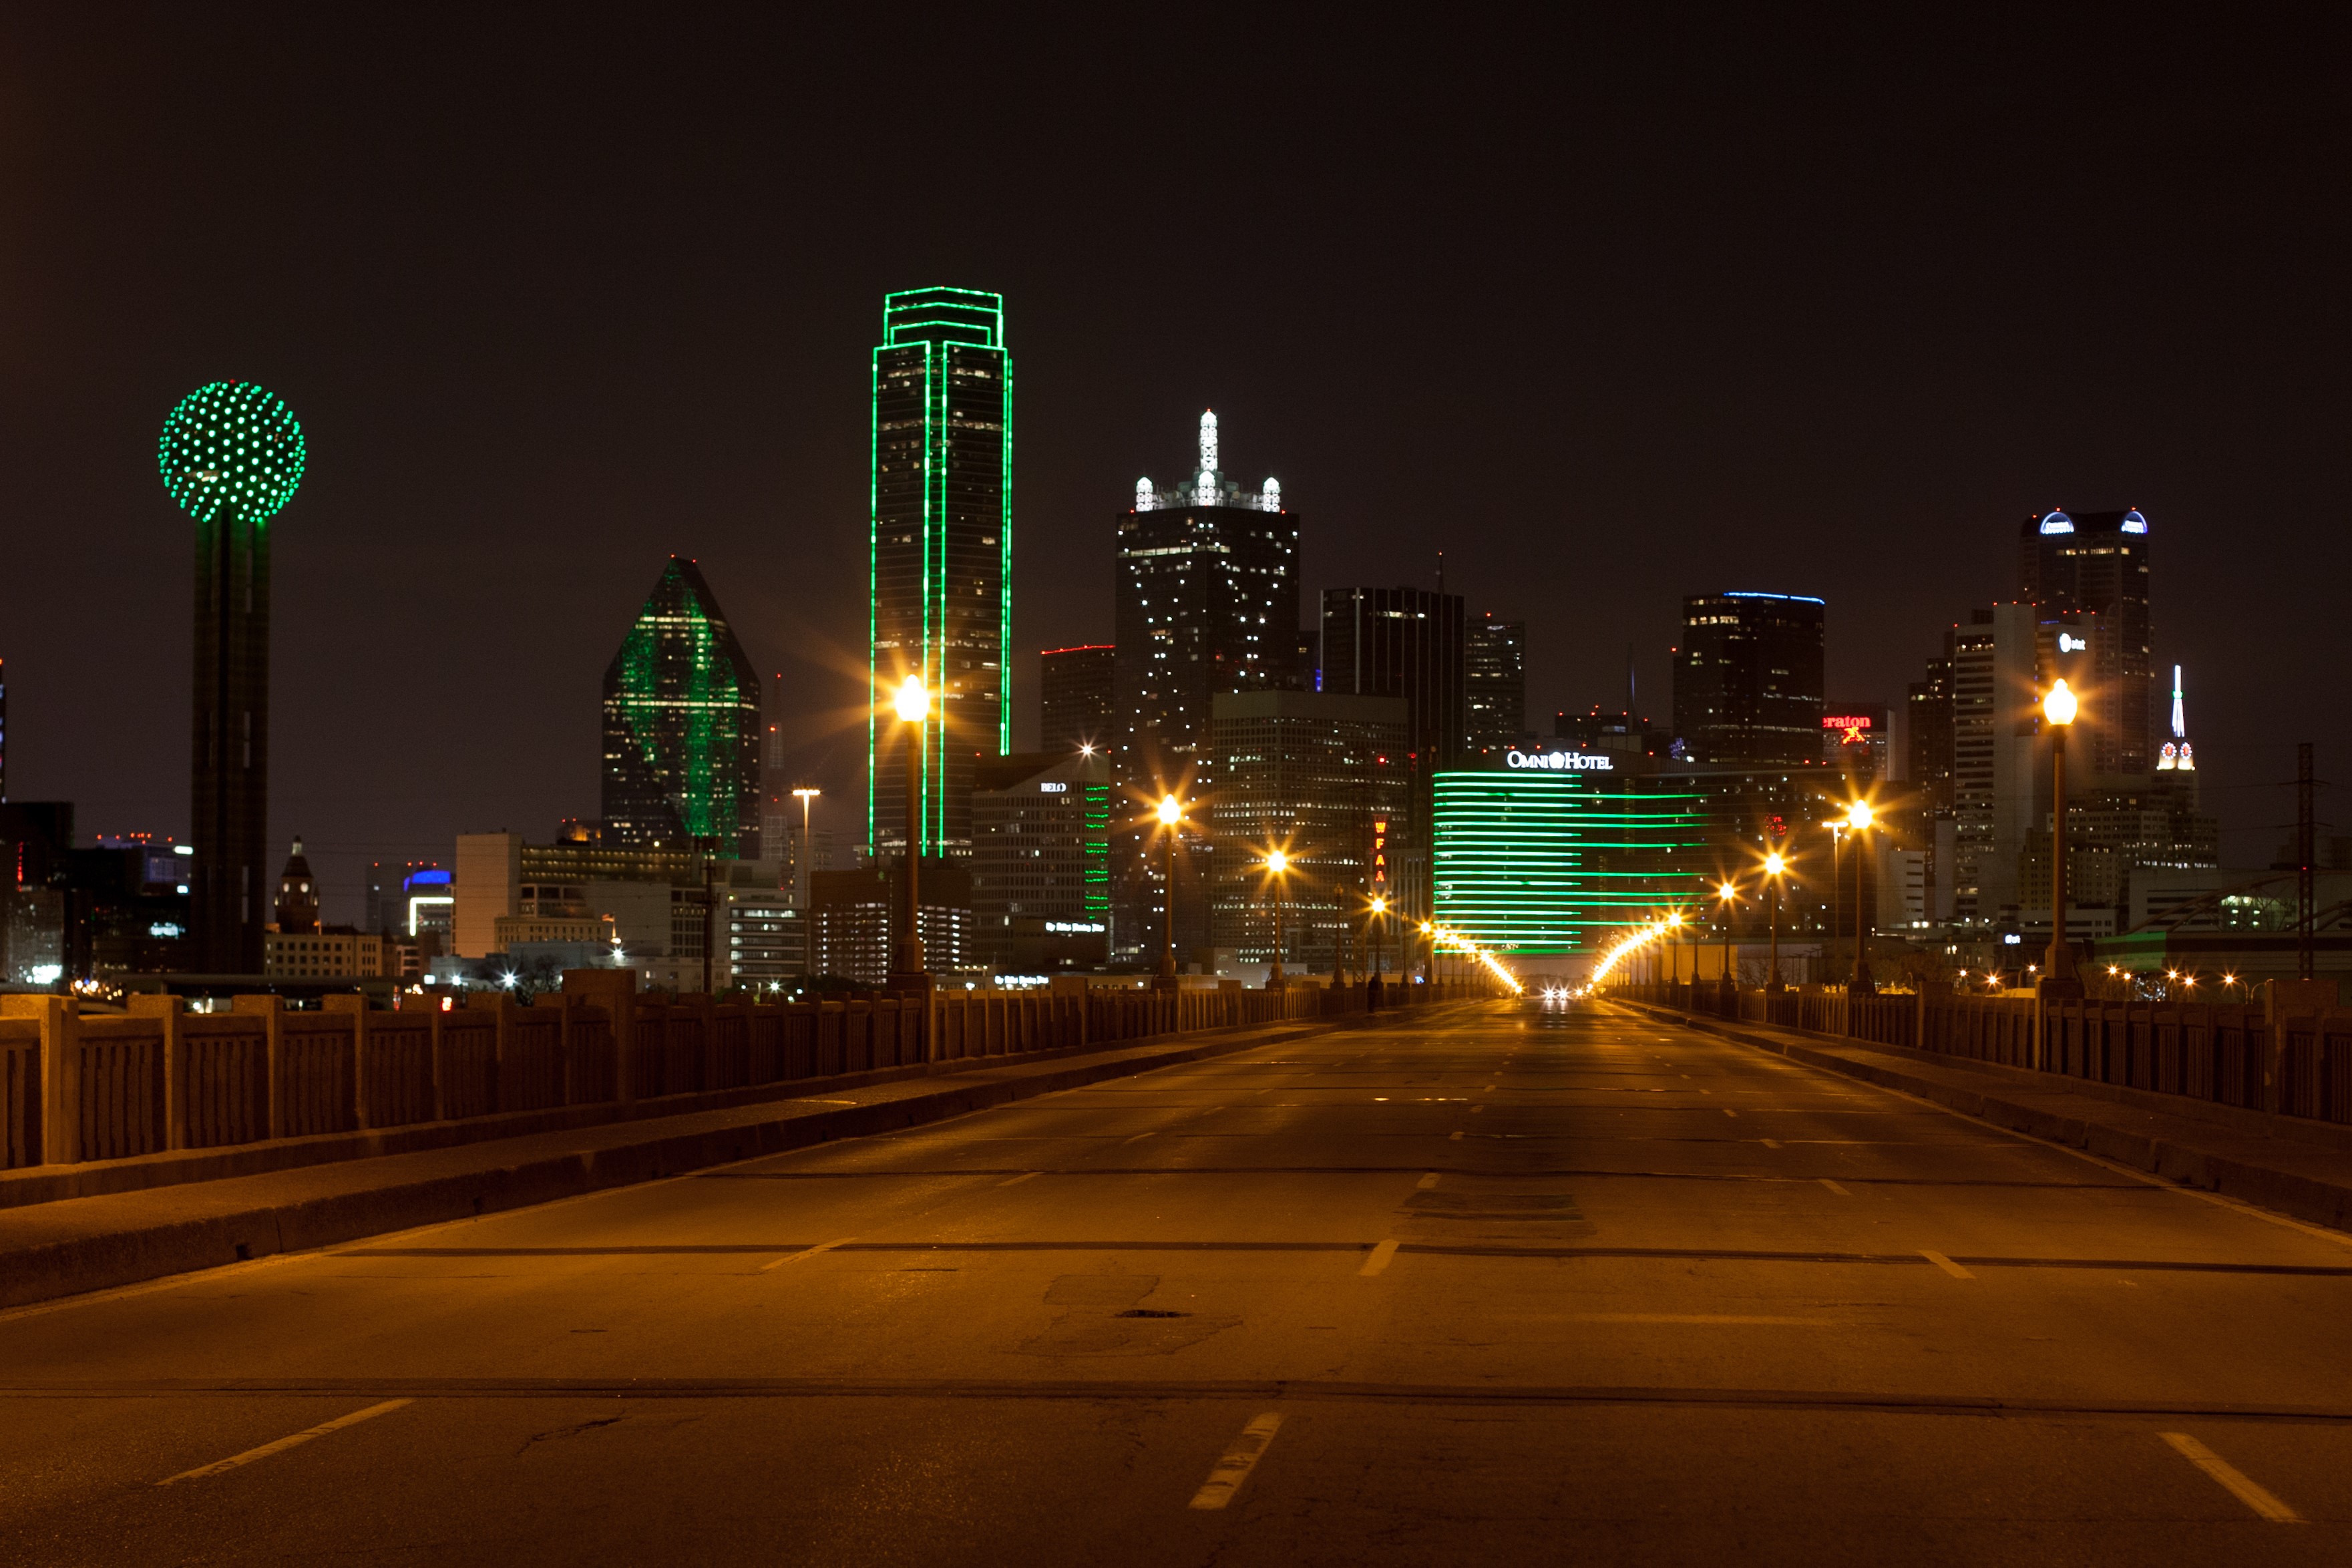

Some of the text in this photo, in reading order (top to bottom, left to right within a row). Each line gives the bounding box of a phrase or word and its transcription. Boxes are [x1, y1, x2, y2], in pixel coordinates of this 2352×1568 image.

[1507, 751, 1613, 770] OMNI HOTEL
[1040, 783, 1066, 793] BELO
[1376, 822, 1386, 881] WFAA
